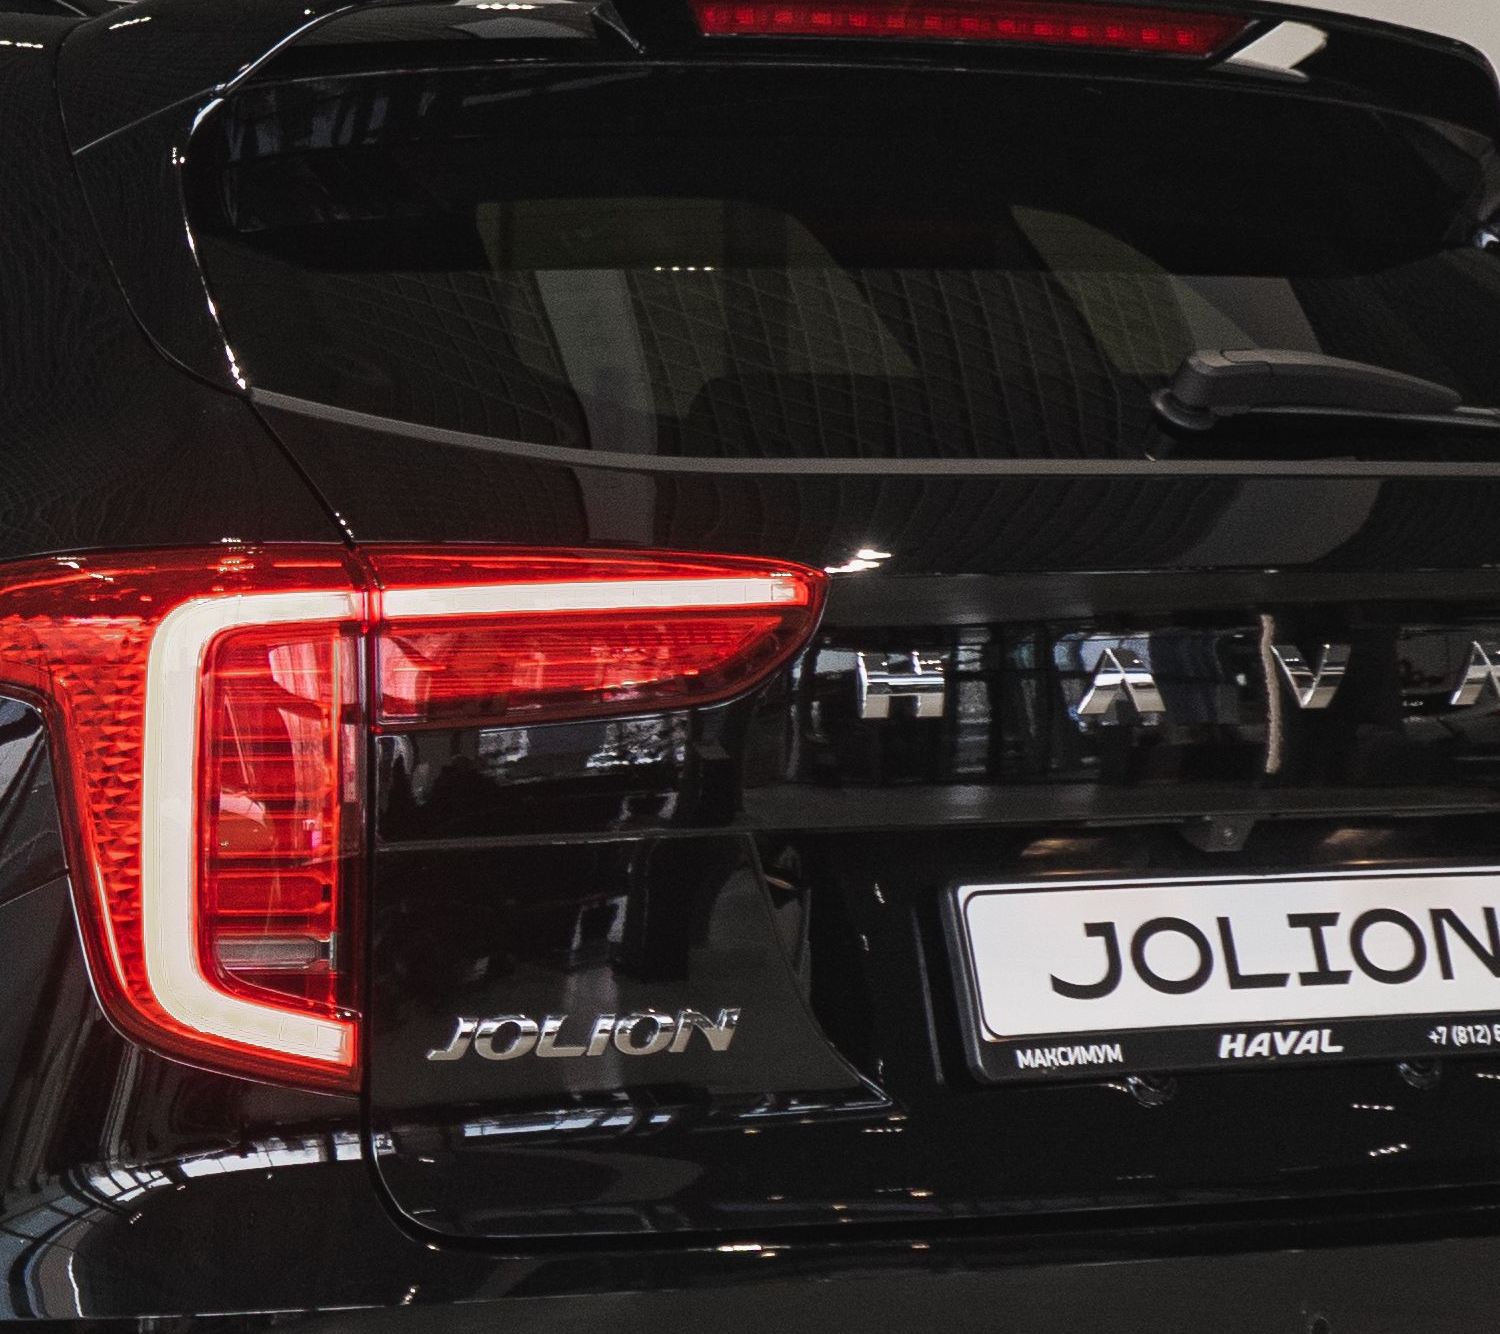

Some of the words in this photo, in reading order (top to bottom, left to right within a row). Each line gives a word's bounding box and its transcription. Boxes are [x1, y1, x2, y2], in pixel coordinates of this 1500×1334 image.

[426, 1007, 743, 1061] JOLION
[1218, 1028, 1344, 1059] HAVAL
[1428, 1025, 1448, 1046] +7
[1451, 1024, 1492, 1047] (812)
[1015, 1043, 1125, 1069] МАКСИМУМ
